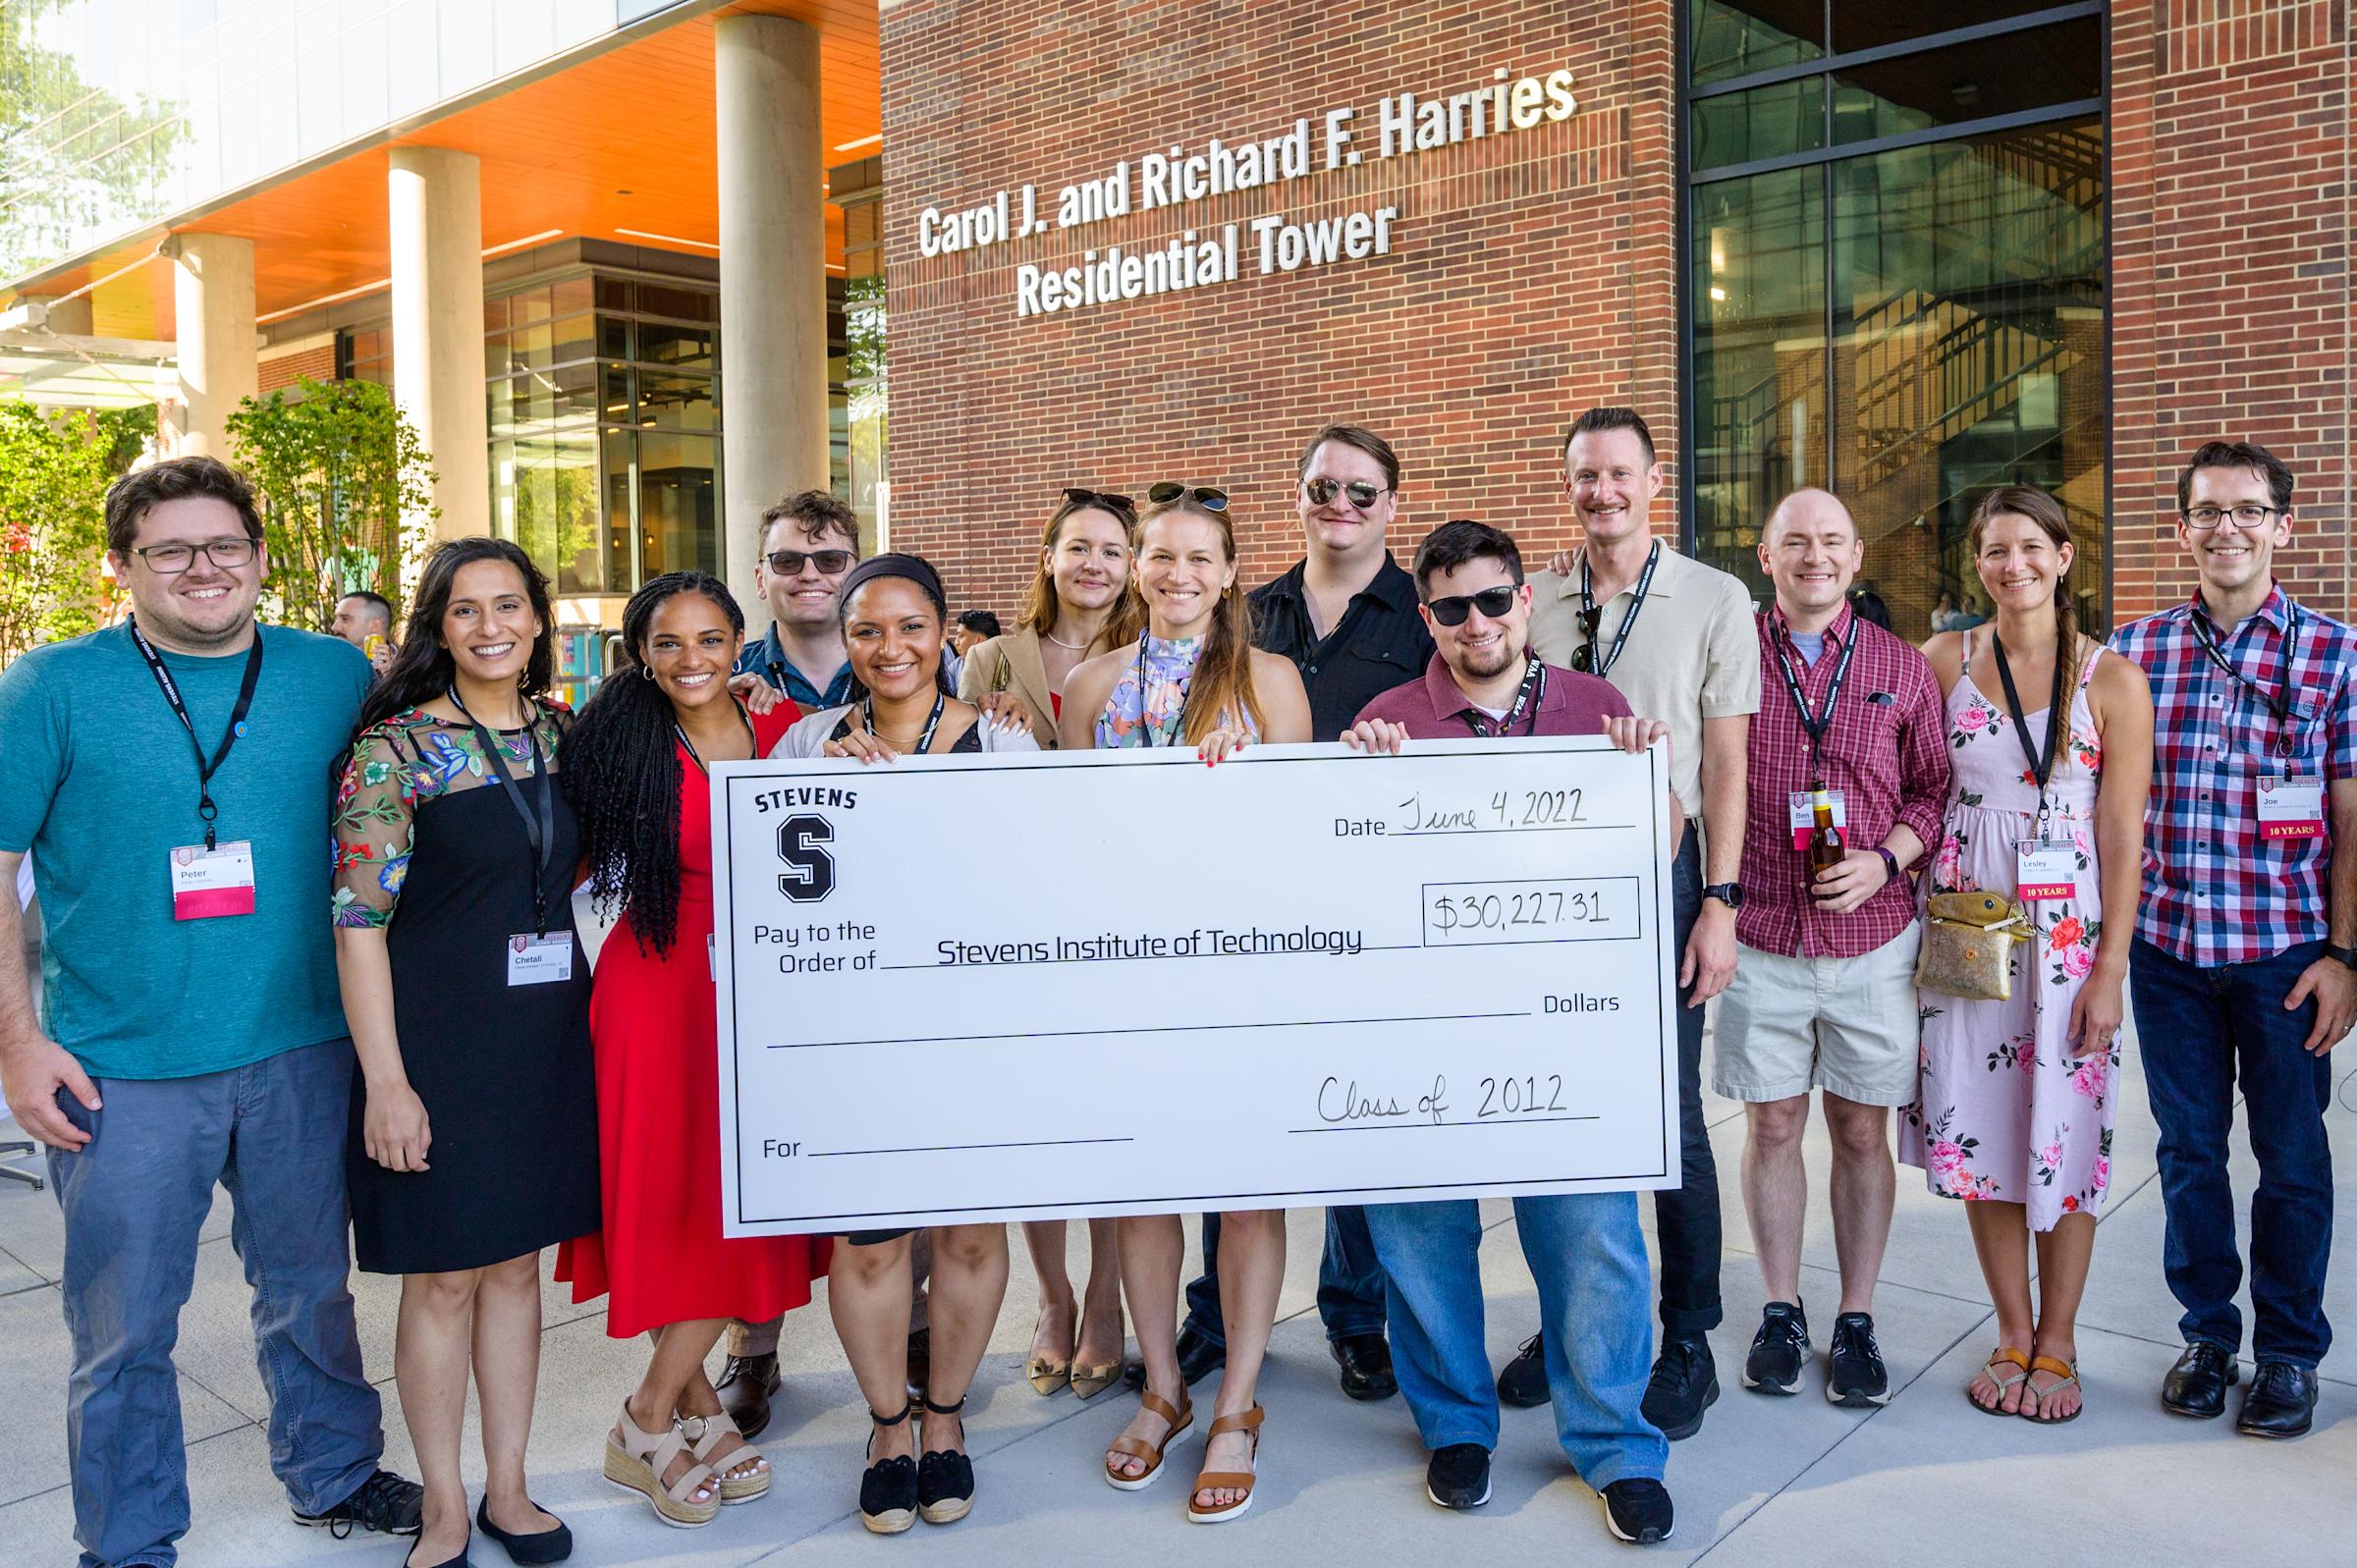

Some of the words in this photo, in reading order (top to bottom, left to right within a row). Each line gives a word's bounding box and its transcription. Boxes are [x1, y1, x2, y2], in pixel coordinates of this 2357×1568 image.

[920, 192, 1008, 258] Carol
[1019, 185, 1048, 238] J.
[1058, 162, 1128, 227] and
[1142, 119, 1309, 207] Richard
[1327, 108, 1362, 169] F.
[1380, 67, 1576, 158] Harries
[1017, 225, 1237, 317] Residential
[1253, 204, 1397, 274] Tower
[755, 787, 857, 813] STEVENS
[1399, 791, 1476, 830] June
[1335, 818, 1385, 836] Date
[2270, 827, 2280, 836] 10
[2281, 826, 2315, 835] YEARS
[777, 813, 835, 903] S
[181, 870, 207, 879] Peter
[2027, 889, 2036, 897] 10
[2037, 887, 2067, 896] YEARS
[1432, 891, 1609, 936] $30,227.31
[755, 925, 798, 948] Pay
[807, 924, 829, 942] to
[838, 921, 875, 940] the
[938, 938, 1048, 966] Stevens
[1056, 934, 1169, 961] Institute
[1174, 930, 1201, 956] of
[1207, 925, 1361, 955] Technology
[515, 955, 542, 964] Chetali
[780, 953, 845, 973] Order
[853, 950, 876, 970] of
[1544, 993, 1619, 1013] Dollars
[1318, 1076, 1410, 1122] Class
[1419, 1075, 1449, 1125] of
[1477, 1075, 1567, 1117] 2012
[763, 1138, 802, 1160] For
